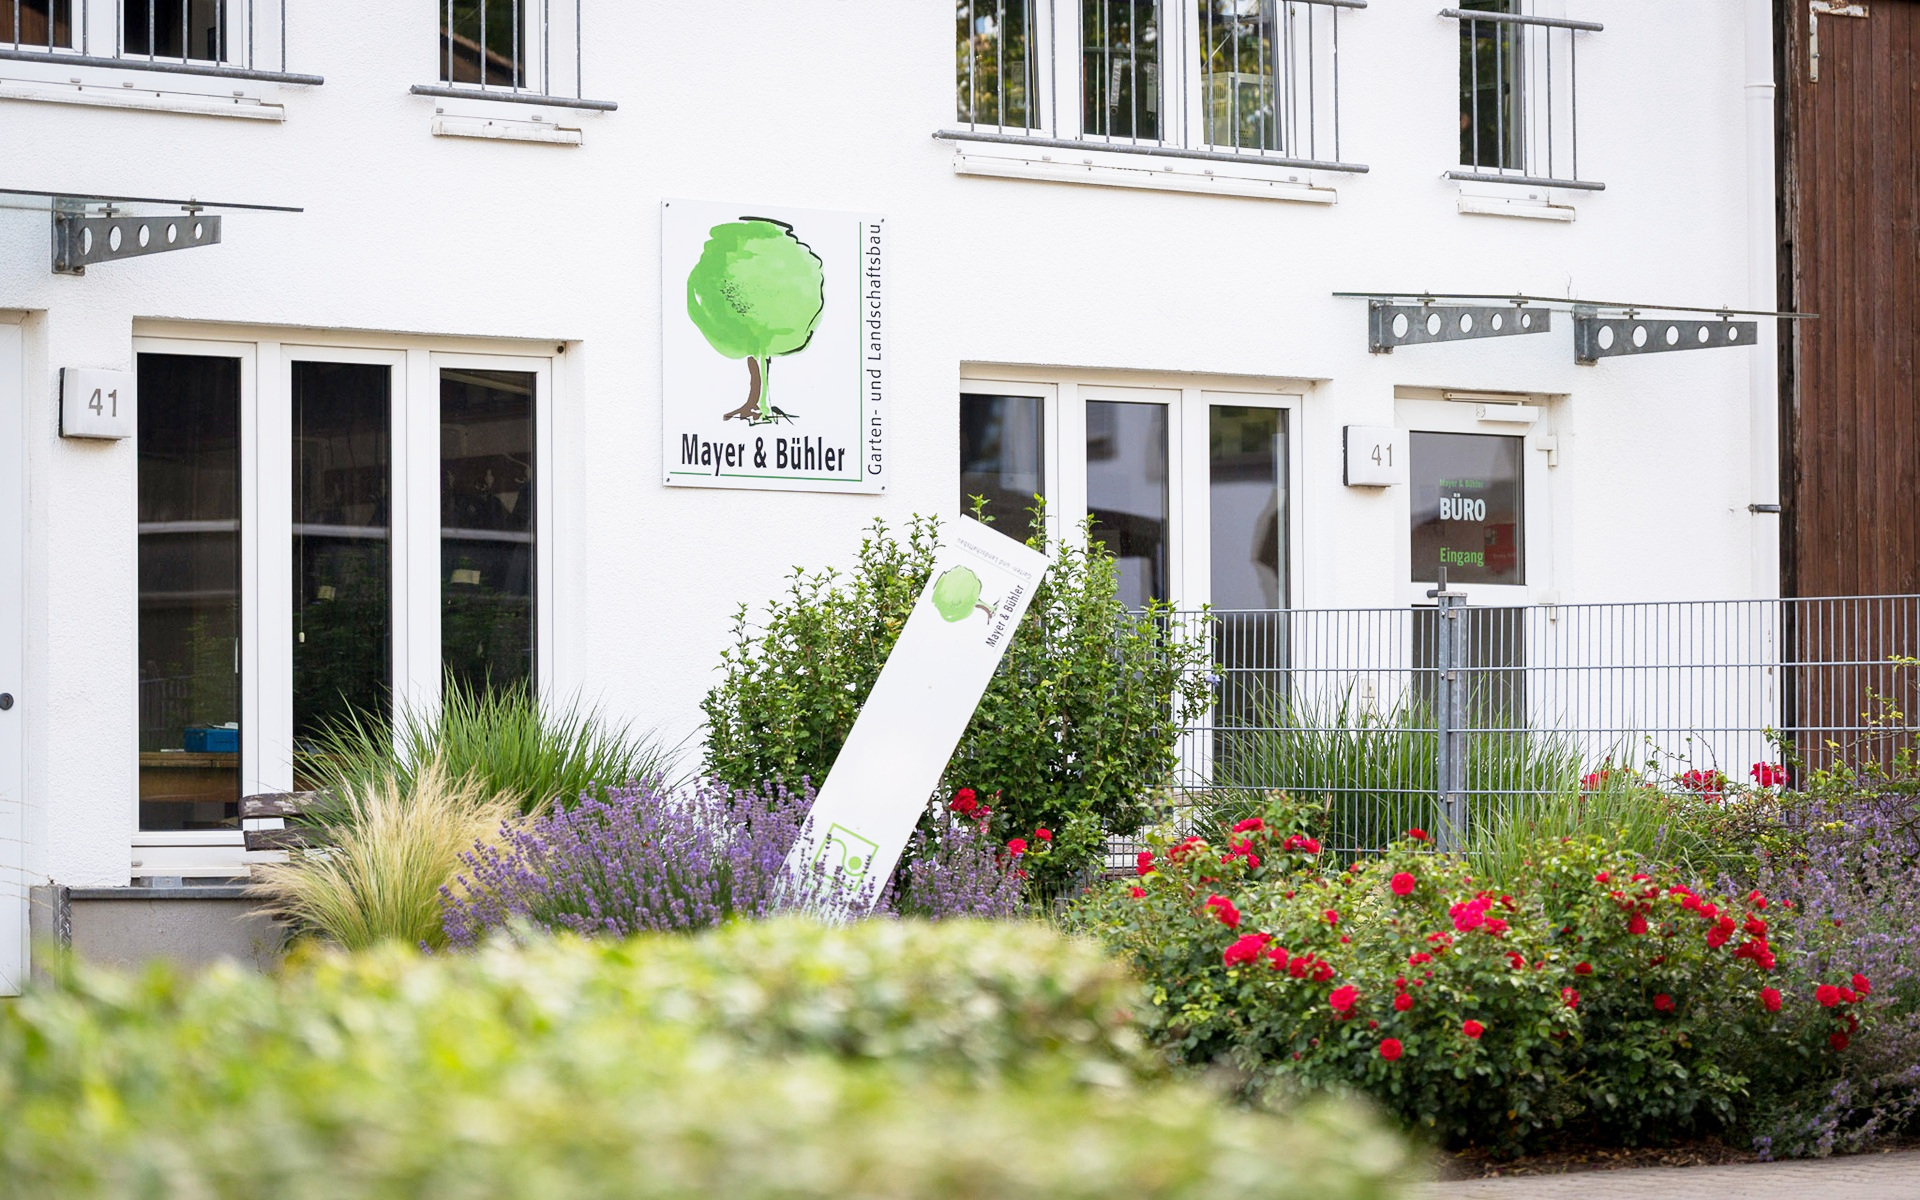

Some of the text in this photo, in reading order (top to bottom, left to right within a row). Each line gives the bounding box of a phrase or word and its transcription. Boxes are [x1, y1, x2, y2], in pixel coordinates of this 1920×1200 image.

[866, 224, 882, 476] Garten- und Landschaftsbau
[88, 388, 117, 417] 41
[681, 433, 845, 477] Mayer & Bühler
[1371, 443, 1392, 467] 41
[1440, 492, 1486, 522] BÜRO
[1440, 547, 1484, 567] Eingang
[985, 584, 1024, 648] Mayer & Bühler
